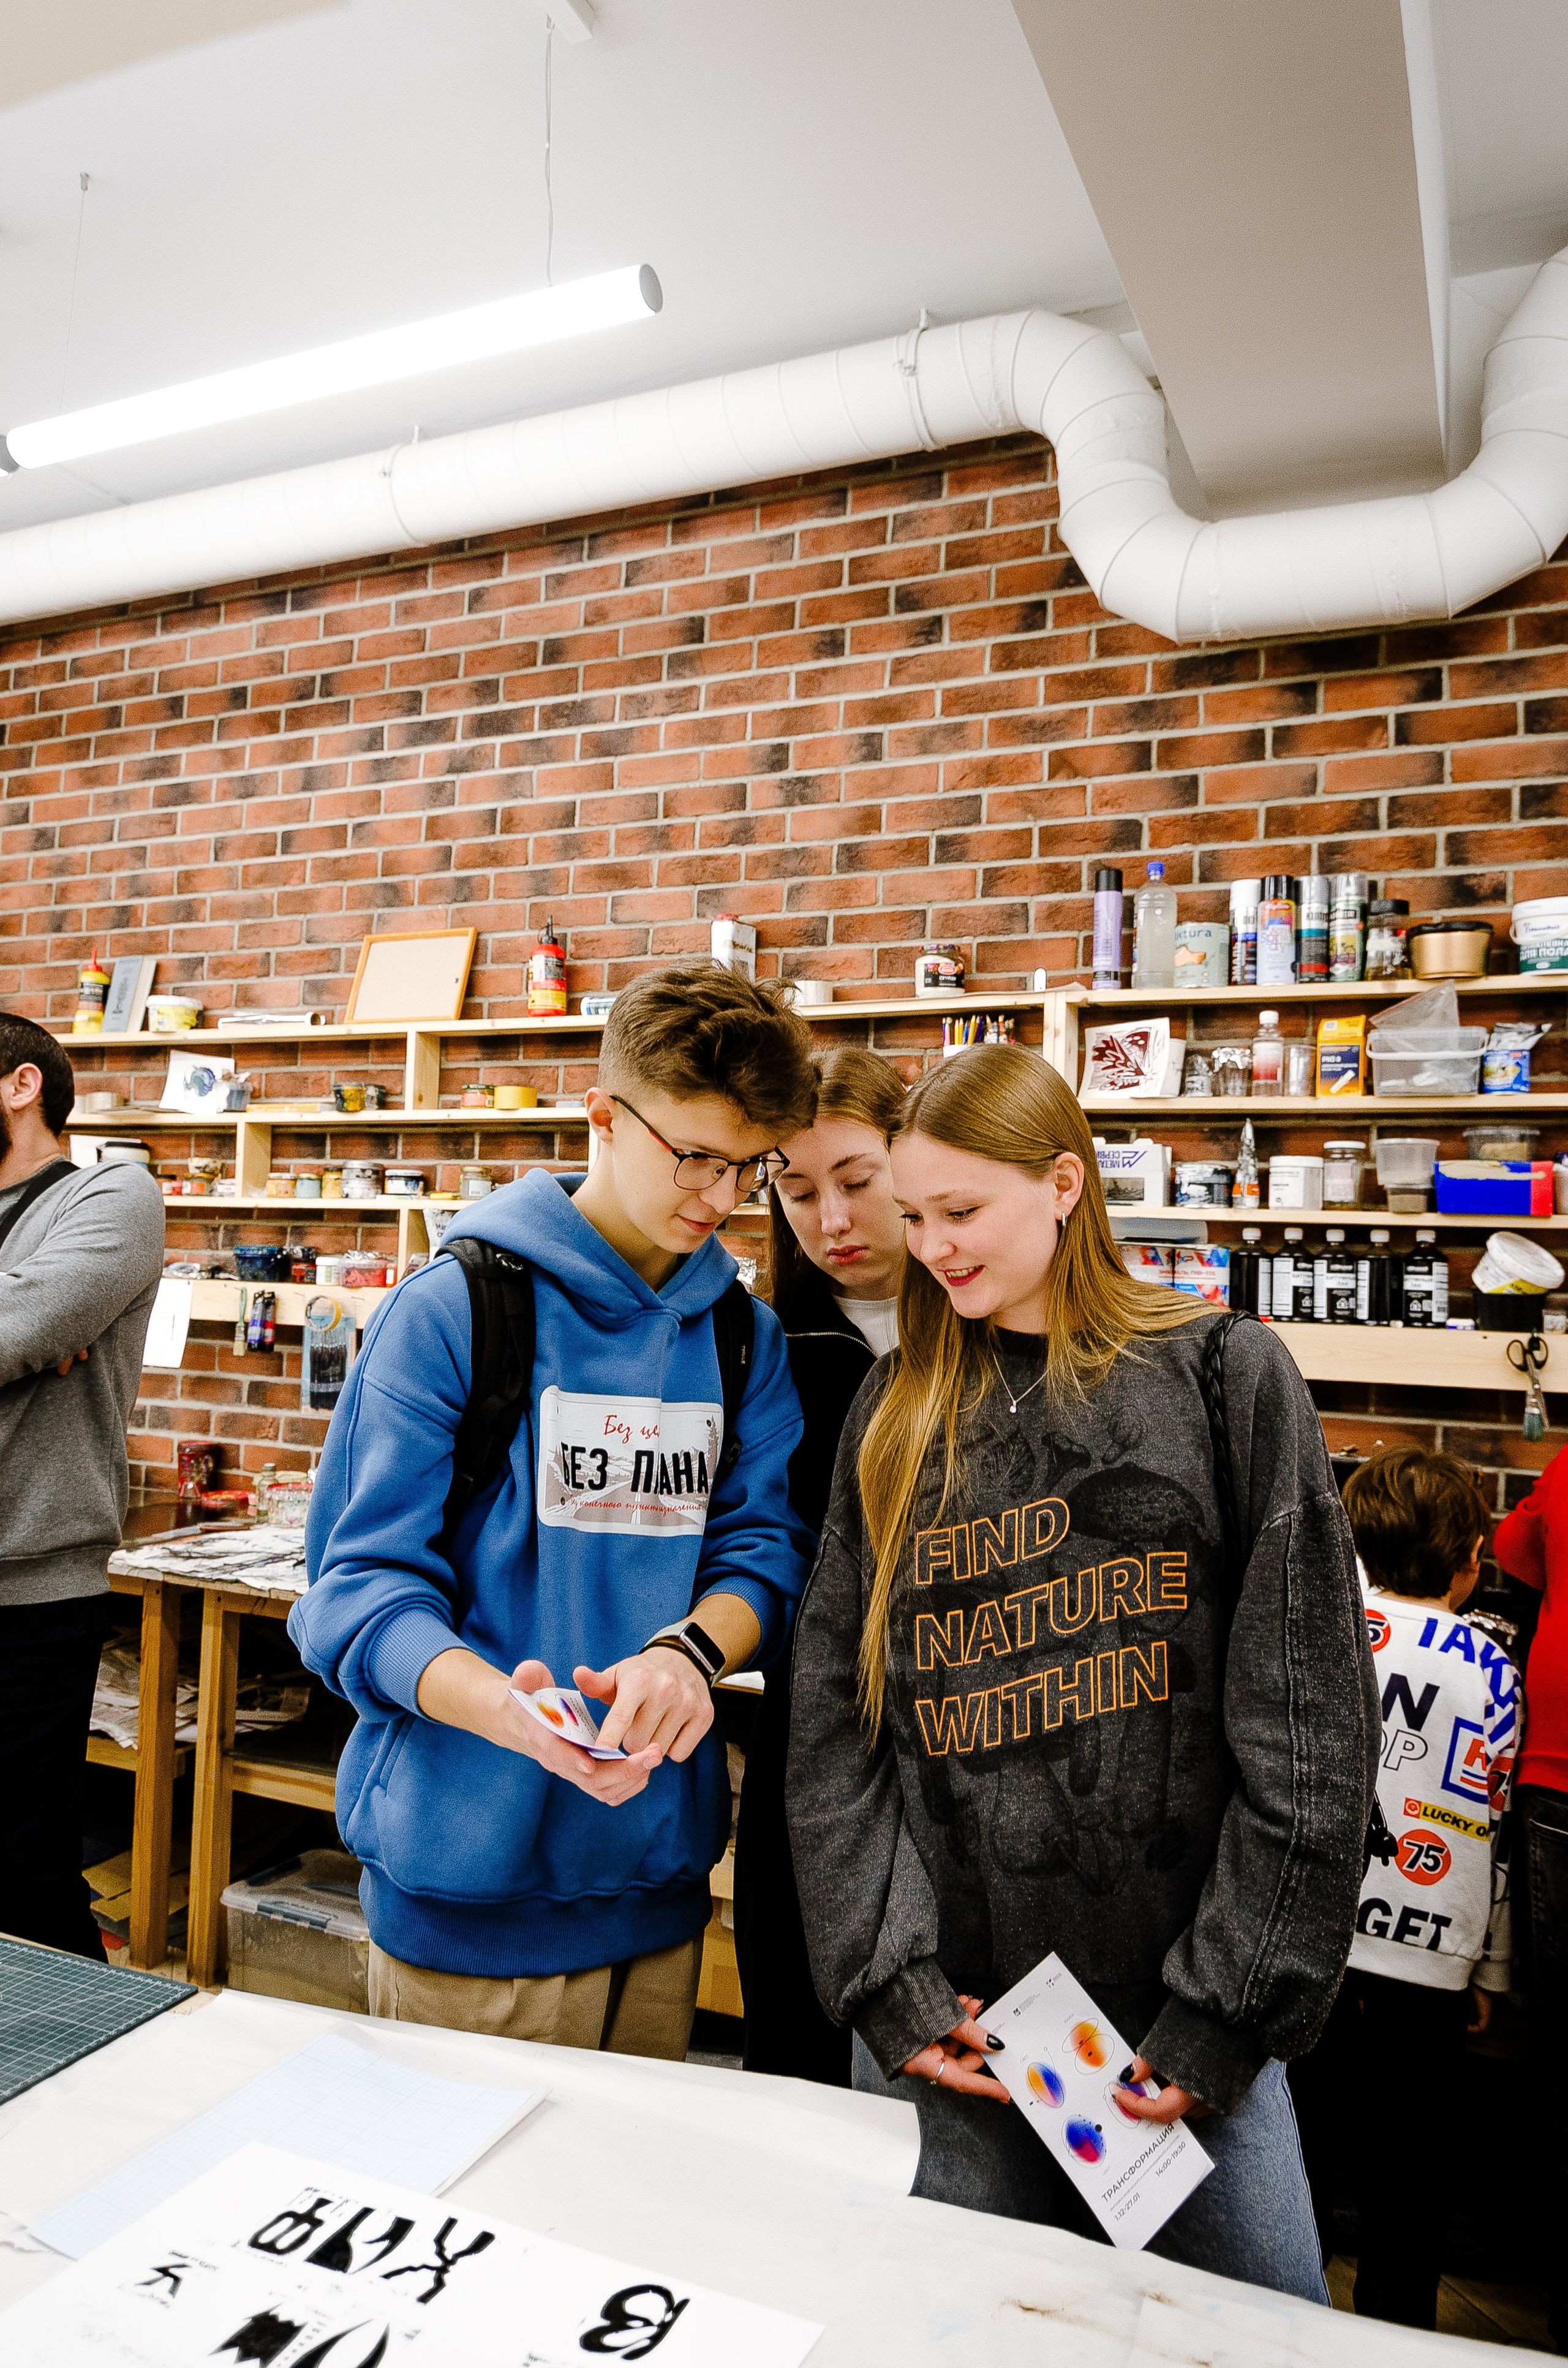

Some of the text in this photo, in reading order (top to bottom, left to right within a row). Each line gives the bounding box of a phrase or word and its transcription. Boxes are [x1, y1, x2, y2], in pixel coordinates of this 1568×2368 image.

[603, 1415, 660, 1443] Без це
[561, 1442, 608, 1490] БЕЗ
[915, 1497, 1070, 1585] FIND
[916, 1551, 1188, 1670] NATURE
[915, 1641, 1169, 1756] WITHIN
[1422, 1806, 1490, 1837] LUCKY O
[1406, 1840, 1446, 1873] 75
[1101, 2122, 1175, 2203] ТРАНСФОРМАЦИЯ
